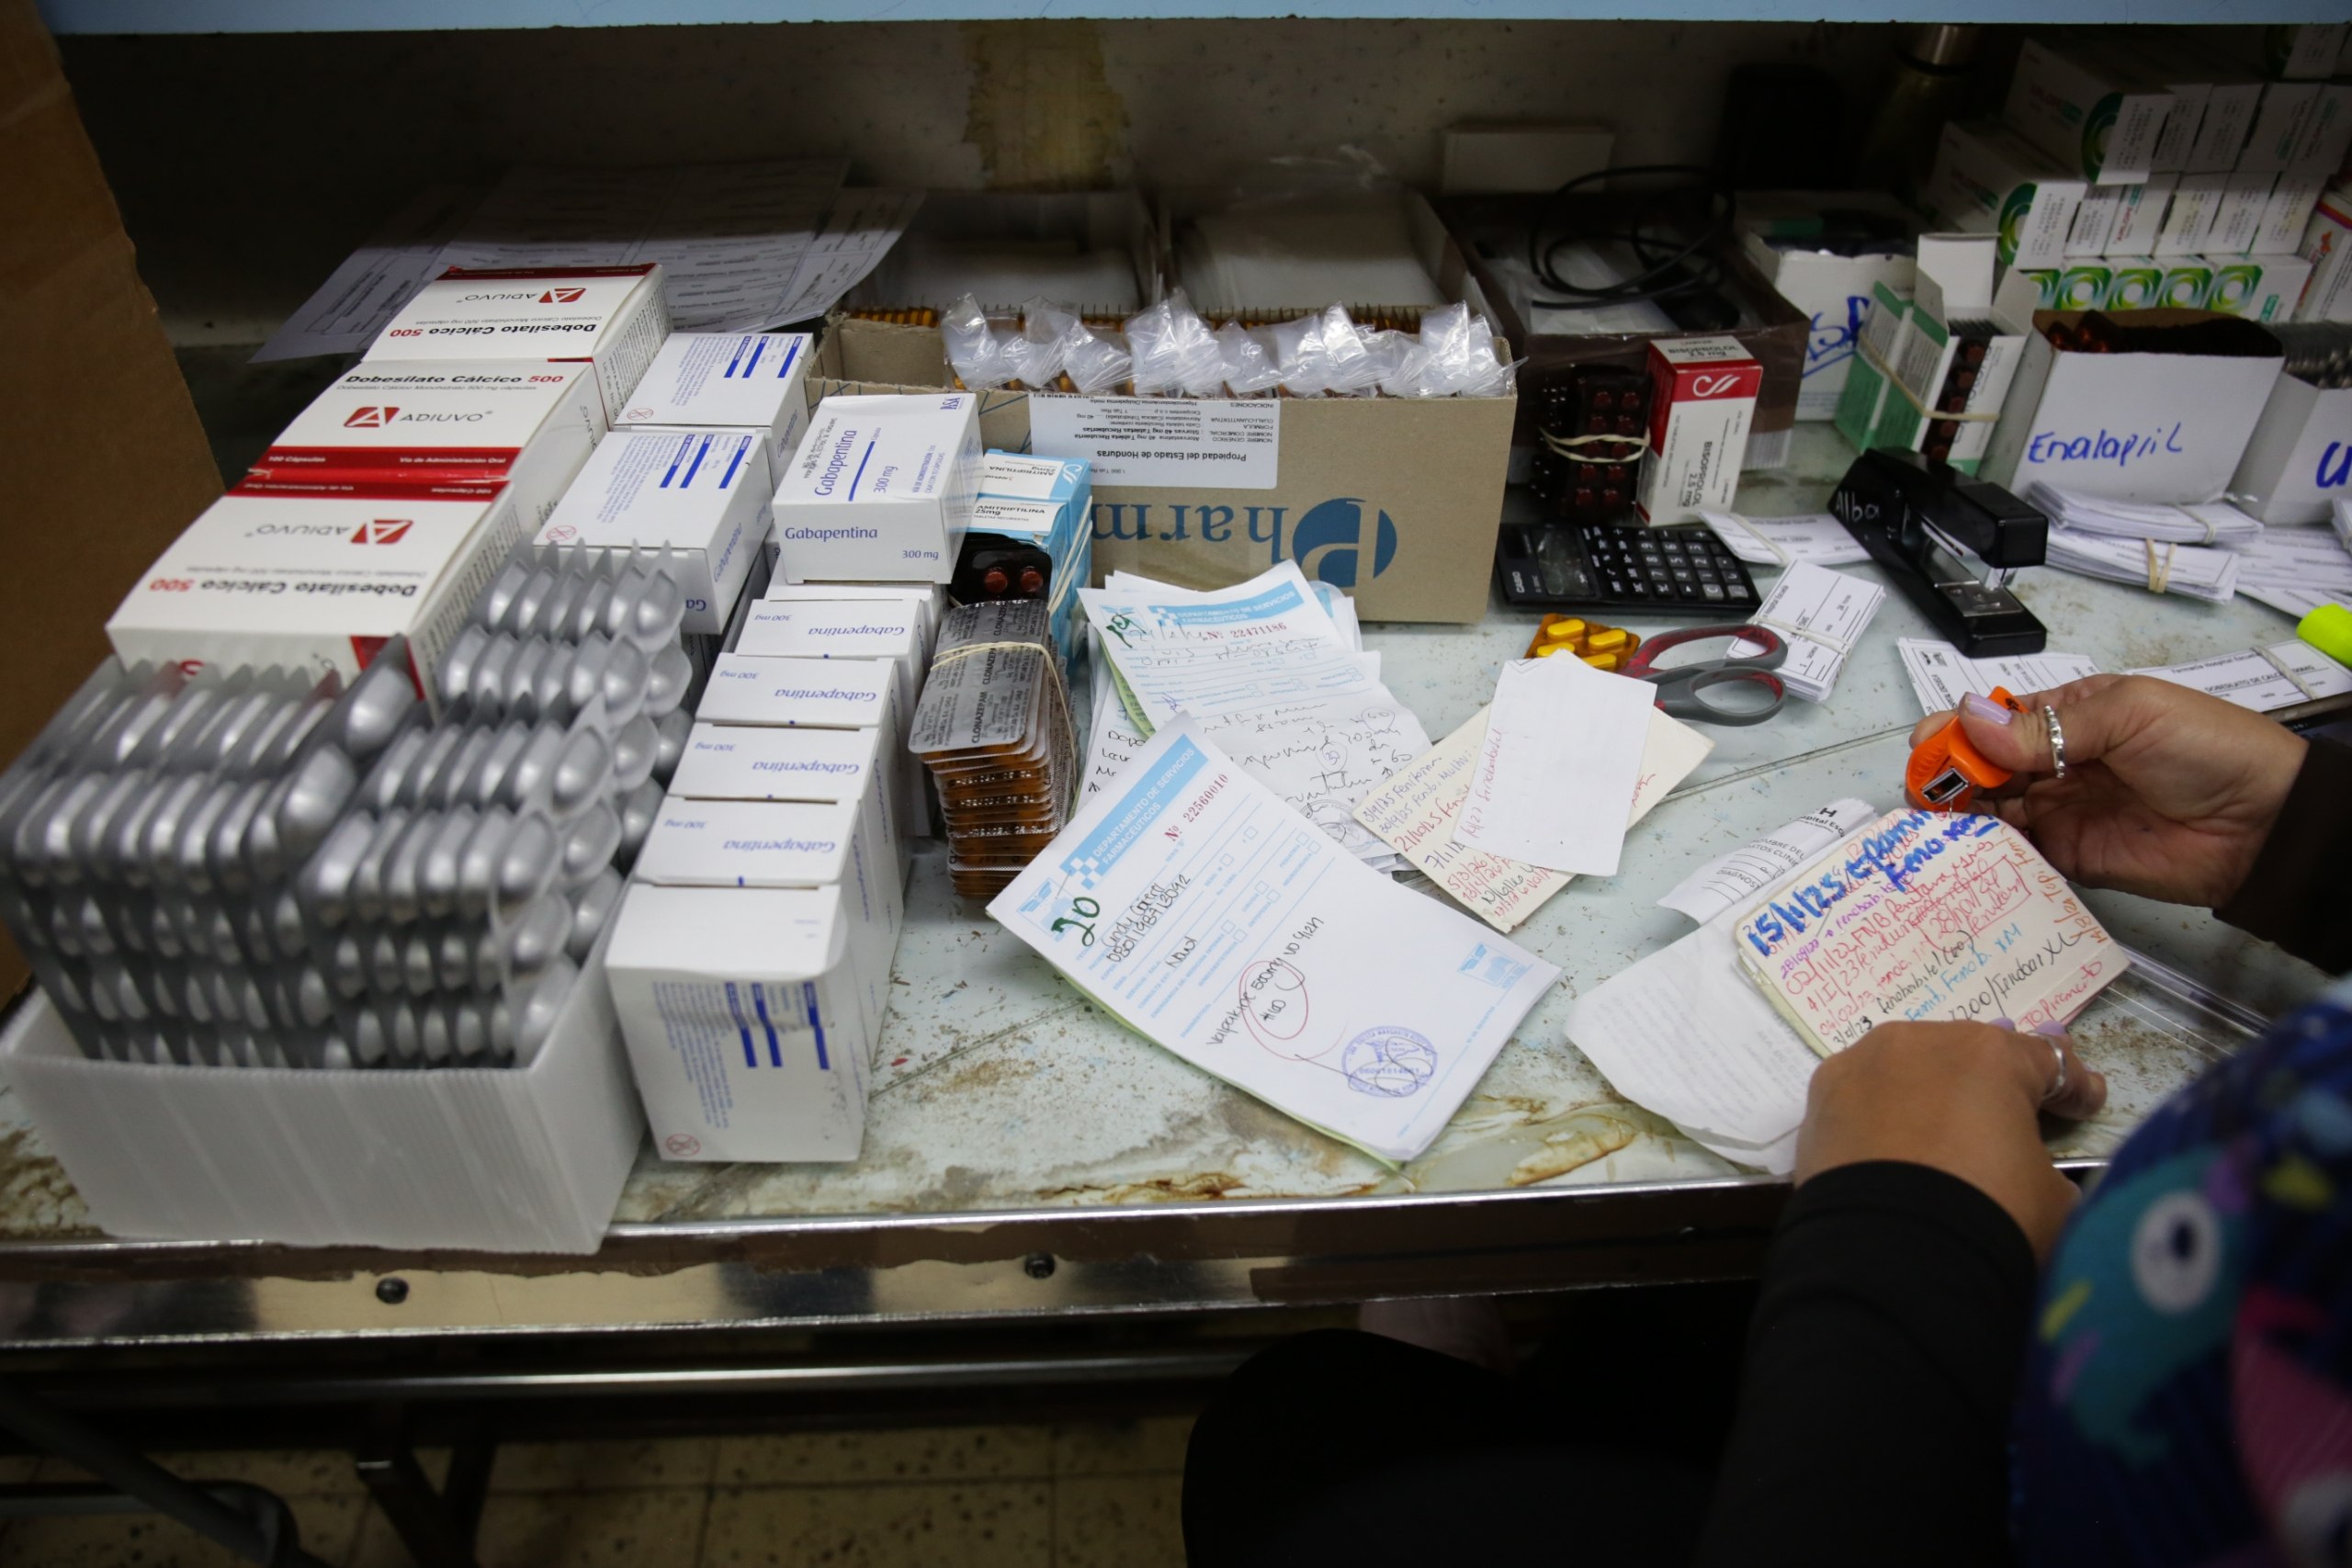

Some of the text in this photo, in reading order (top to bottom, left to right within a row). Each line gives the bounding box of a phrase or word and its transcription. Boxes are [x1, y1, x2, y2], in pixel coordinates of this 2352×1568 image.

[390, 324, 596, 337] Dobesilato Cálcico 500
[1097, 450, 1138, 458] Honduras
[1154, 451, 1184, 459] Estado
[1187, 452, 1200, 460] del
[1203, 452, 1246, 461] Propiedad
[815, 430, 858, 496] Gabapentina
[989, 467, 1055, 476] AMITRIPTILINA
[1692, 441, 1713, 507] BISOPROLOL
[874, 466, 898, 493] 300 mg
[1682, 491, 1696, 507] mg
[978, 505, 1045, 513] AMITRIPTILINA
[1836, 491, 1879, 523] Alba
[255, 525, 351, 536] ADIUVO
[786, 526, 877, 542] Gabapentina
[902, 550, 938, 560] 300 mg
[150, 579, 417, 597] Dobesilato Cálcico 500
[1511, 571, 1524, 593] CASIO
[753, 614, 770, 623] mg
[808, 626, 906, 637] Gabapentina
[1229, 622, 1288, 639] 22471186
[983, 648, 996, 684] CLONAZEPA
[718, 670, 760, 680] 300 mg
[2205, 678, 2249, 693] DOBESILATO
[774, 688, 877, 703] Gabapentina
[972, 692, 987, 743] CLONAZEPAM
[694, 741, 736, 753] 300 mg
[752, 760, 860, 775] Gabapentina
[1093, 795, 1150, 858] DEPARTAMENTO
[1147, 784, 1160, 799] DE
[1157, 747, 1196, 789] SERVICIOS
[1182, 773, 1229, 822] 22560010
[722, 839, 837, 854] Gabapentina
